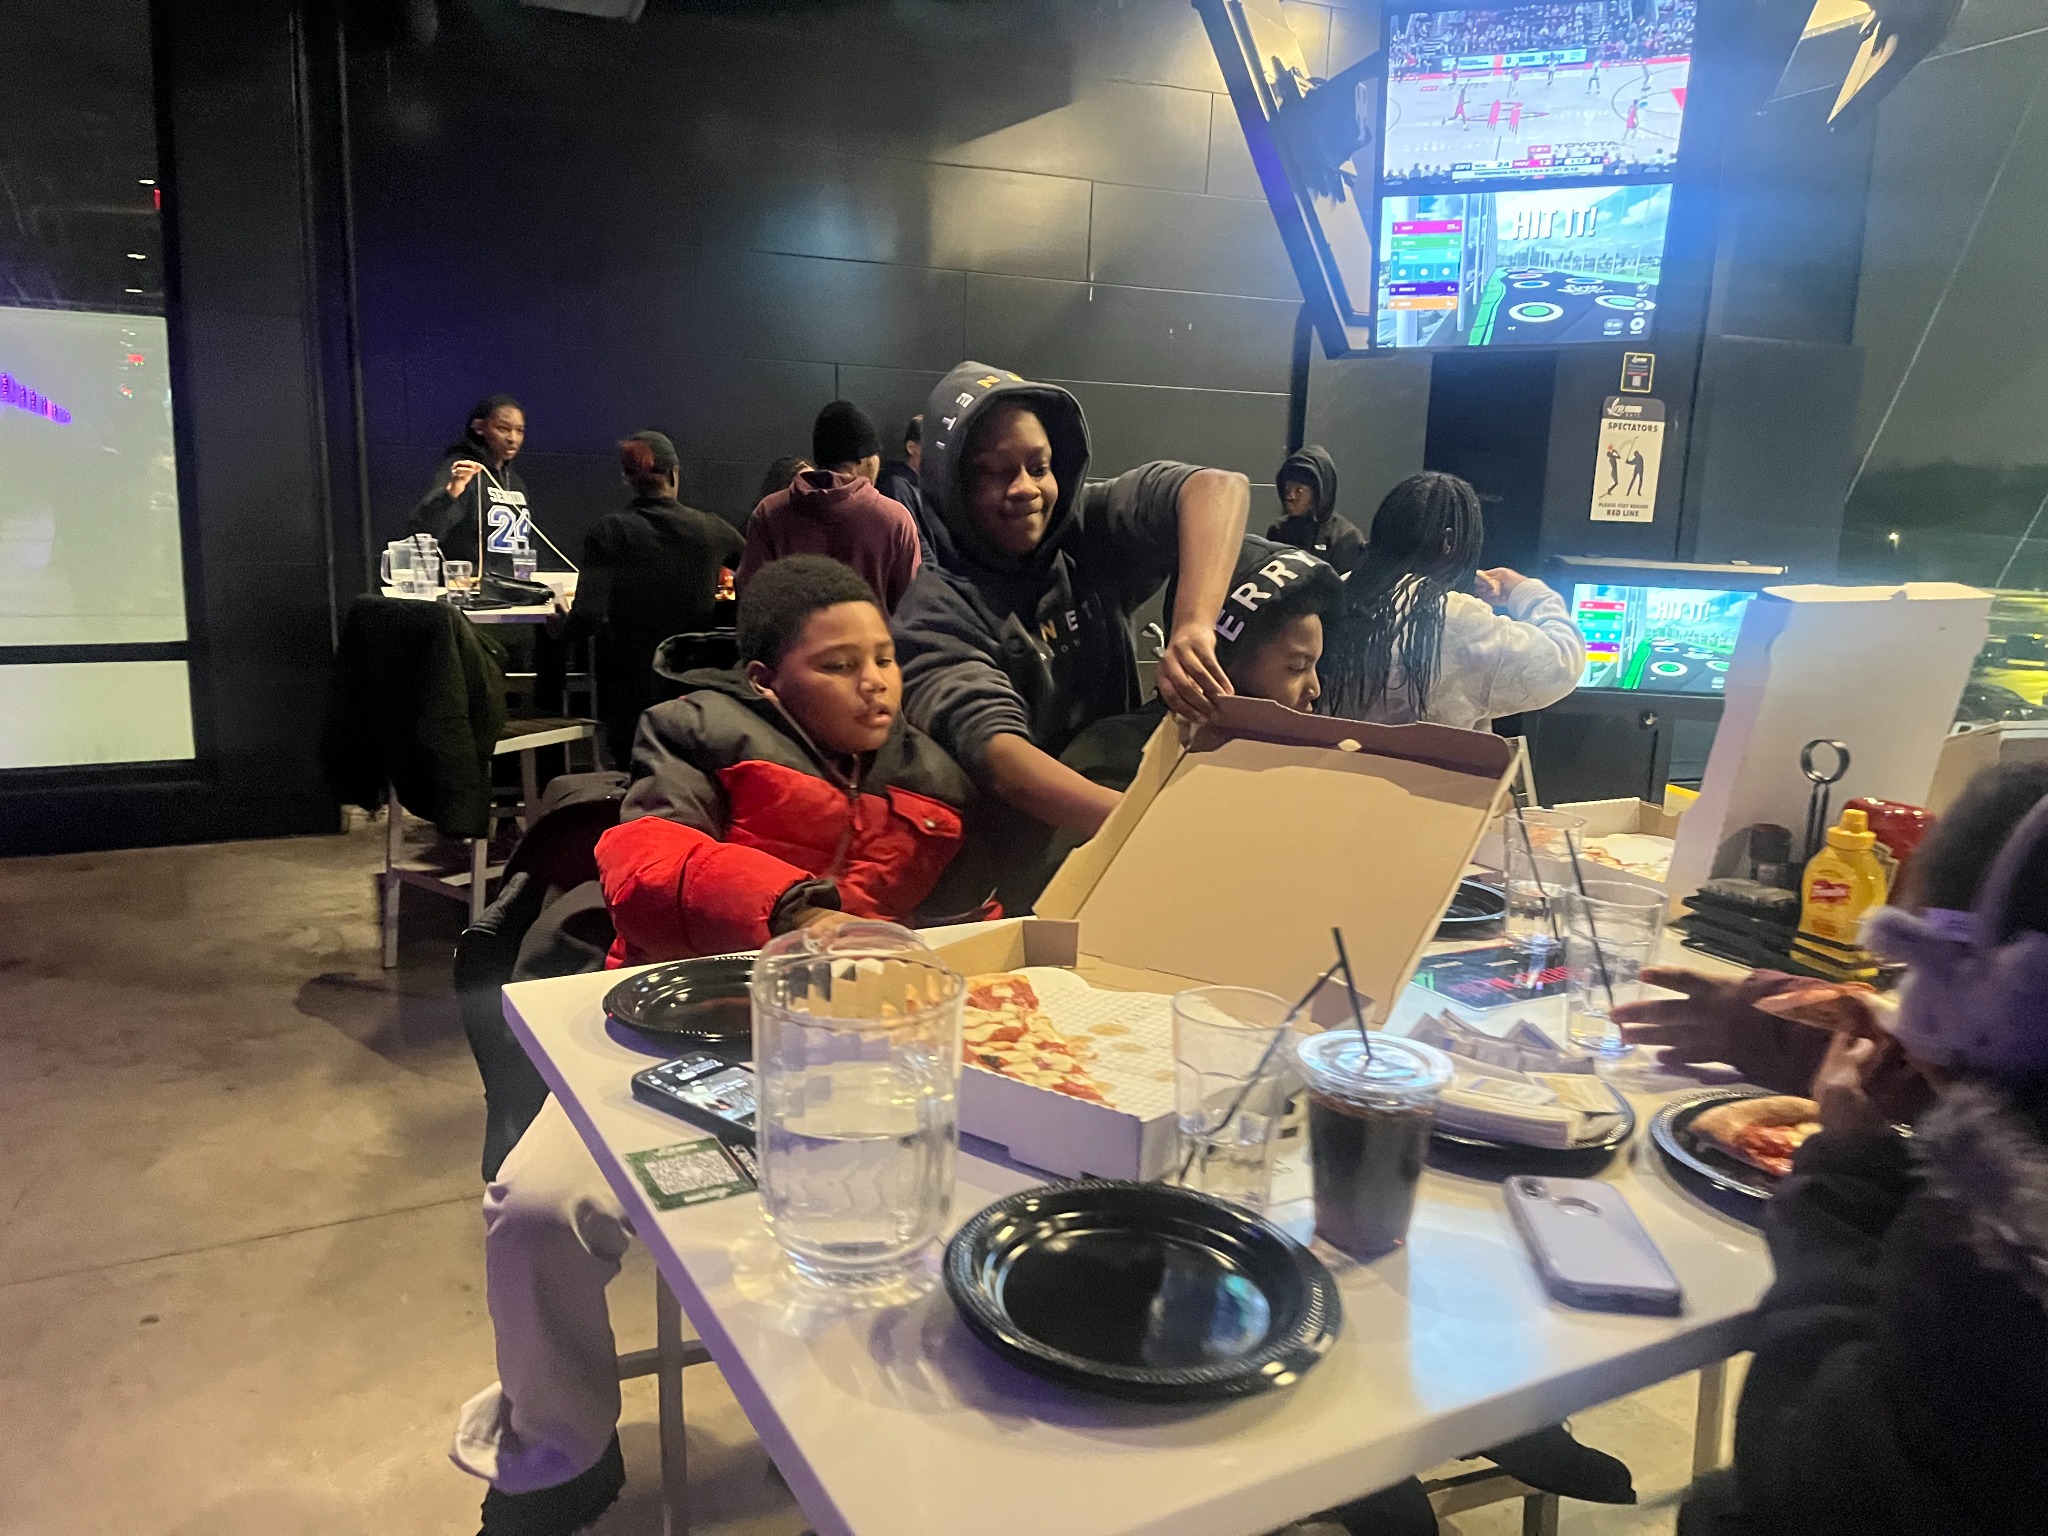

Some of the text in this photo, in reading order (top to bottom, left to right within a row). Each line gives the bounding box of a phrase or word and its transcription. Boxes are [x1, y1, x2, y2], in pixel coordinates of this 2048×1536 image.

[1555, 141, 1619, 149] TOYOTA
[1511, 206, 1599, 240] HIT IT!
[1608, 422, 1658, 432] SPECTATORS
[487, 504, 530, 554] 24
[1655, 600, 1688, 621] HIT
